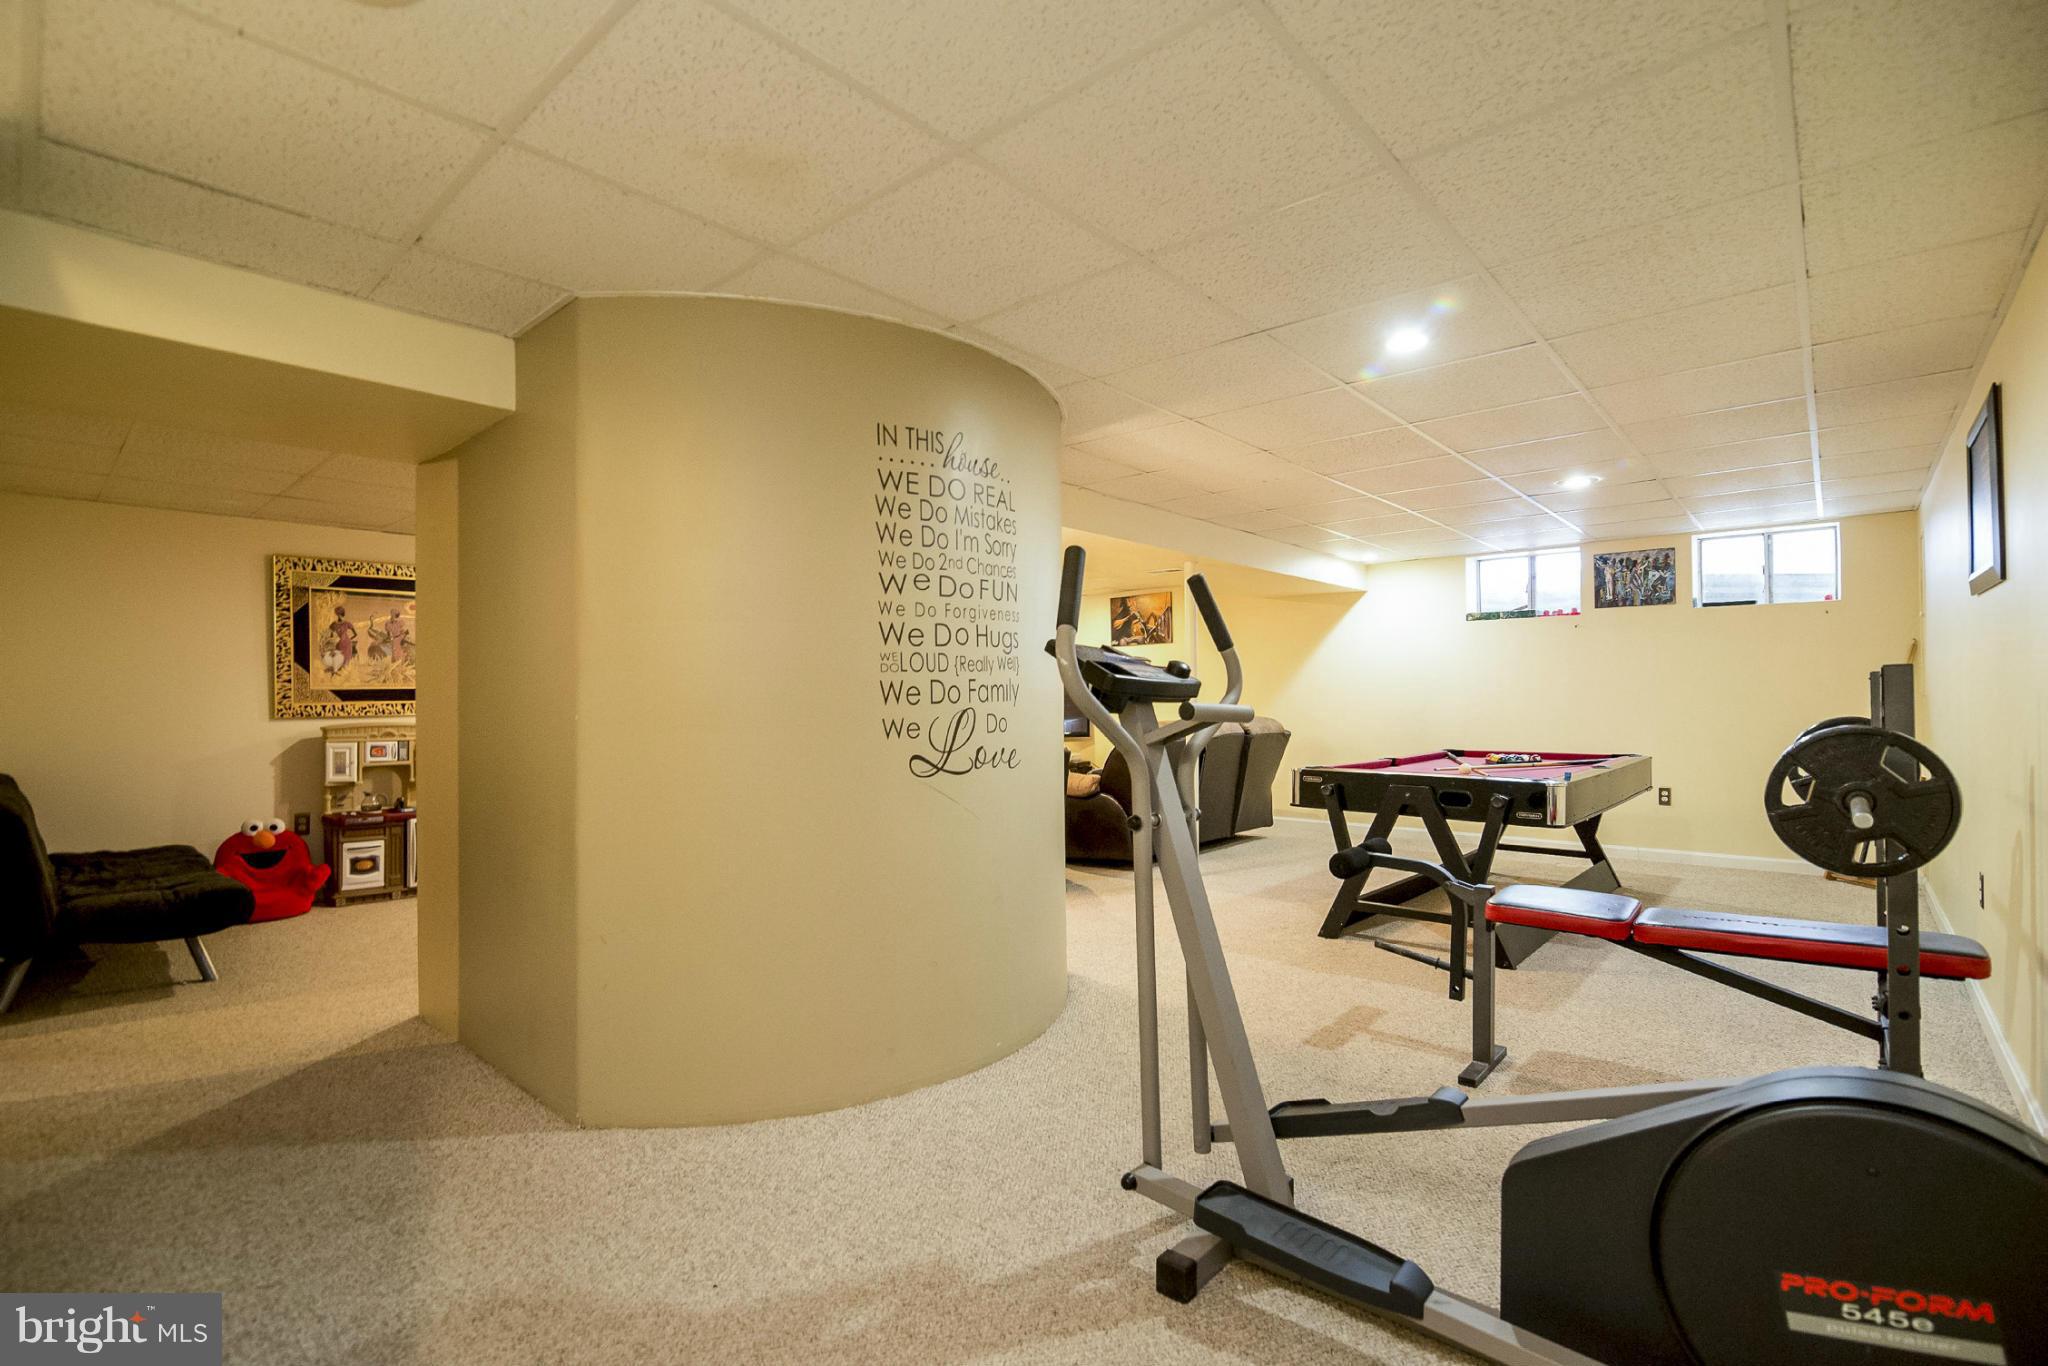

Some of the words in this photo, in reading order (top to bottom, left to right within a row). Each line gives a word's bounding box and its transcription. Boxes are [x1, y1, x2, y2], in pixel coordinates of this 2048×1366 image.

[876, 422, 898, 447] IN
[905, 426, 944, 454] THIS
[877, 468, 919, 495] WE
[929, 475, 966, 501] DO
[973, 483, 1016, 513] REAL
[875, 494, 911, 519] We
[919, 499, 948, 523] Do
[954, 504, 1017, 536] Mistakes
[875, 521, 913, 547] We
[921, 525, 949, 550] Do
[955, 529, 979, 553] I'm
[984, 532, 1017, 563] Sorry
[878, 550, 906, 569] We
[912, 552, 935, 571] Do
[938, 553, 963, 571] 2nd
[966, 557, 1016, 580] Chances
[878, 572, 931, 596] We
[939, 575, 974, 599] Do
[980, 579, 1018, 602] FUN
[878, 600, 906, 617] We
[914, 602, 937, 617] Do
[945, 603, 1020, 624] Forgiveness
[878, 621, 924, 647] We
[934, 623, 969, 647] Do
[976, 624, 1019, 655] Hugs
[880, 651, 898, 661] WE
[880, 663, 899, 673] DO
[900, 652, 949, 673] LOUD
[880, 680, 921, 706] We
[930, 679, 961, 704] Do
[968, 678, 1020, 707] Family
[882, 718, 921, 740] We
[986, 713, 1008, 733] Do
[909, 707, 1022, 778] Love
